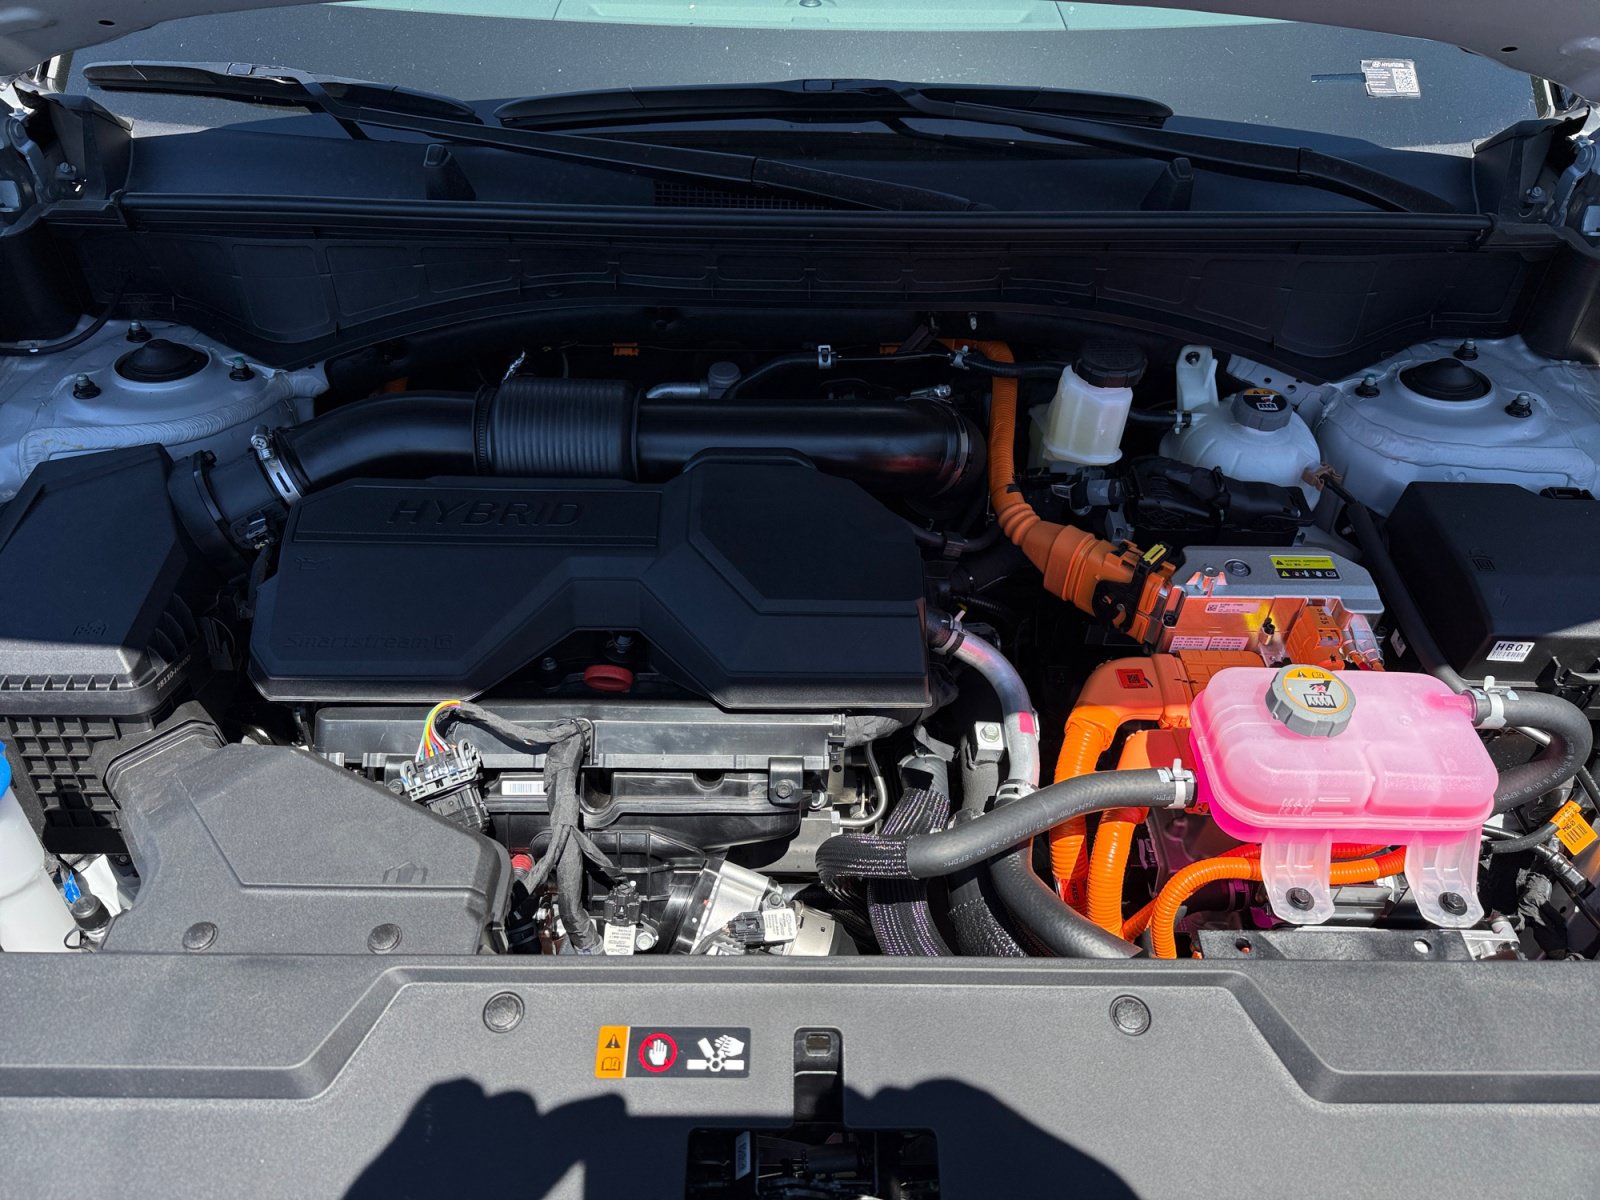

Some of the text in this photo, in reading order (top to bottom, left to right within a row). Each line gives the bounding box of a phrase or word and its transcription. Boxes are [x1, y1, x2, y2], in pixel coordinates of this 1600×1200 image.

[386, 498, 585, 527] HYBRID
[282, 633, 427, 649] Smartstream
[1495, 643, 1531, 652] HB01
